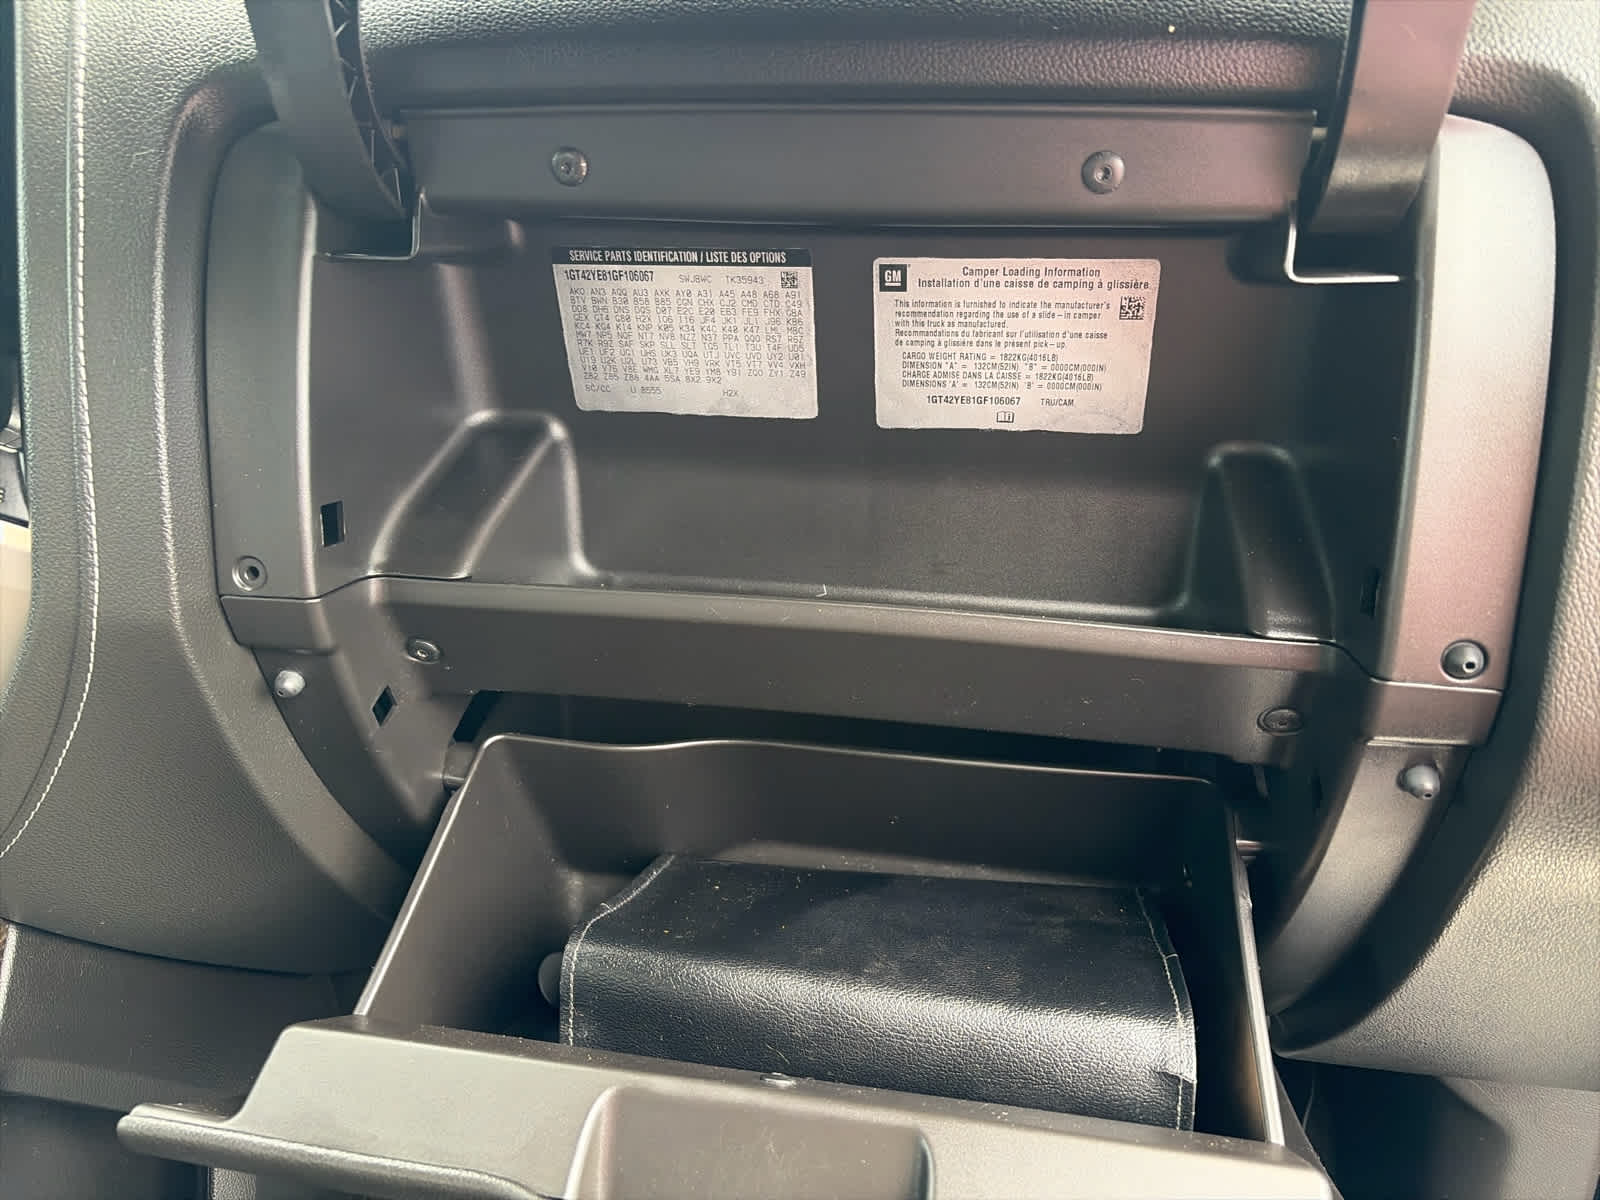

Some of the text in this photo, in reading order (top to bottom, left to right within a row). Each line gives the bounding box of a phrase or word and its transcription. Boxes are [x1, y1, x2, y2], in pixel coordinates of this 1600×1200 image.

[569, 250, 603, 262] SERVICE
[604, 250, 632, 262] PARTS
[634, 251, 698, 263] IDENTIFICATION
[706, 251, 729, 263] LISTE
[731, 251, 748, 263] DES
[749, 252, 787, 264] OPTIONS
[564, 269, 654, 282] 1GT42YE81GF106067
[725, 275, 765, 285] TK35943
[884, 269, 902, 282] GM
[962, 266, 1101, 279] Camper Loading Information
[918, 278, 1149, 291] Installation d'une caisse de camping à glissière
[895, 300, 1111, 310] This information is furnished to indicate the manufacturer's
[895, 310, 954, 318] recommendation
[956, 310, 990, 320] regarding
[993, 311, 1004, 319] the
[1022, 311, 1030, 319] of
[912, 320, 925, 328] this
[927, 320, 945, 328] truck
[958, 320, 1009, 329] manufactured.
[895, 329, 959, 337] Recommandations
[961, 329, 970, 338] du
[972, 329, 1004, 338] fabricant
[1019, 330, 1060, 339] l'utilisation
[1062, 330, 1082, 339] d'une
[1085, 331, 1108, 339] caisse
[895, 339, 903, 347] de
[905, 340, 935, 348] camping
[976, 340, 993, 348] dans
[995, 340, 1001, 348] le
[902, 352, 926, 360] CARGO
[929, 352, 956, 360] WEIGHT
[960, 352, 987, 361] RATING
[902, 361, 942, 369] DIMENSION
[902, 370, 931, 379] CHARGE
[933, 371, 960, 379] ADMISE
[962, 371, 982, 380] DANS
[985, 371, 994, 380] LA
[996, 372, 1022, 380] CAISSE
[902, 380, 947, 388] DIMENSIONS
[722, 389, 739, 397] H2X
[927, 395, 1075, 407] 1GT42YE81GF106067 TRU/CAM
